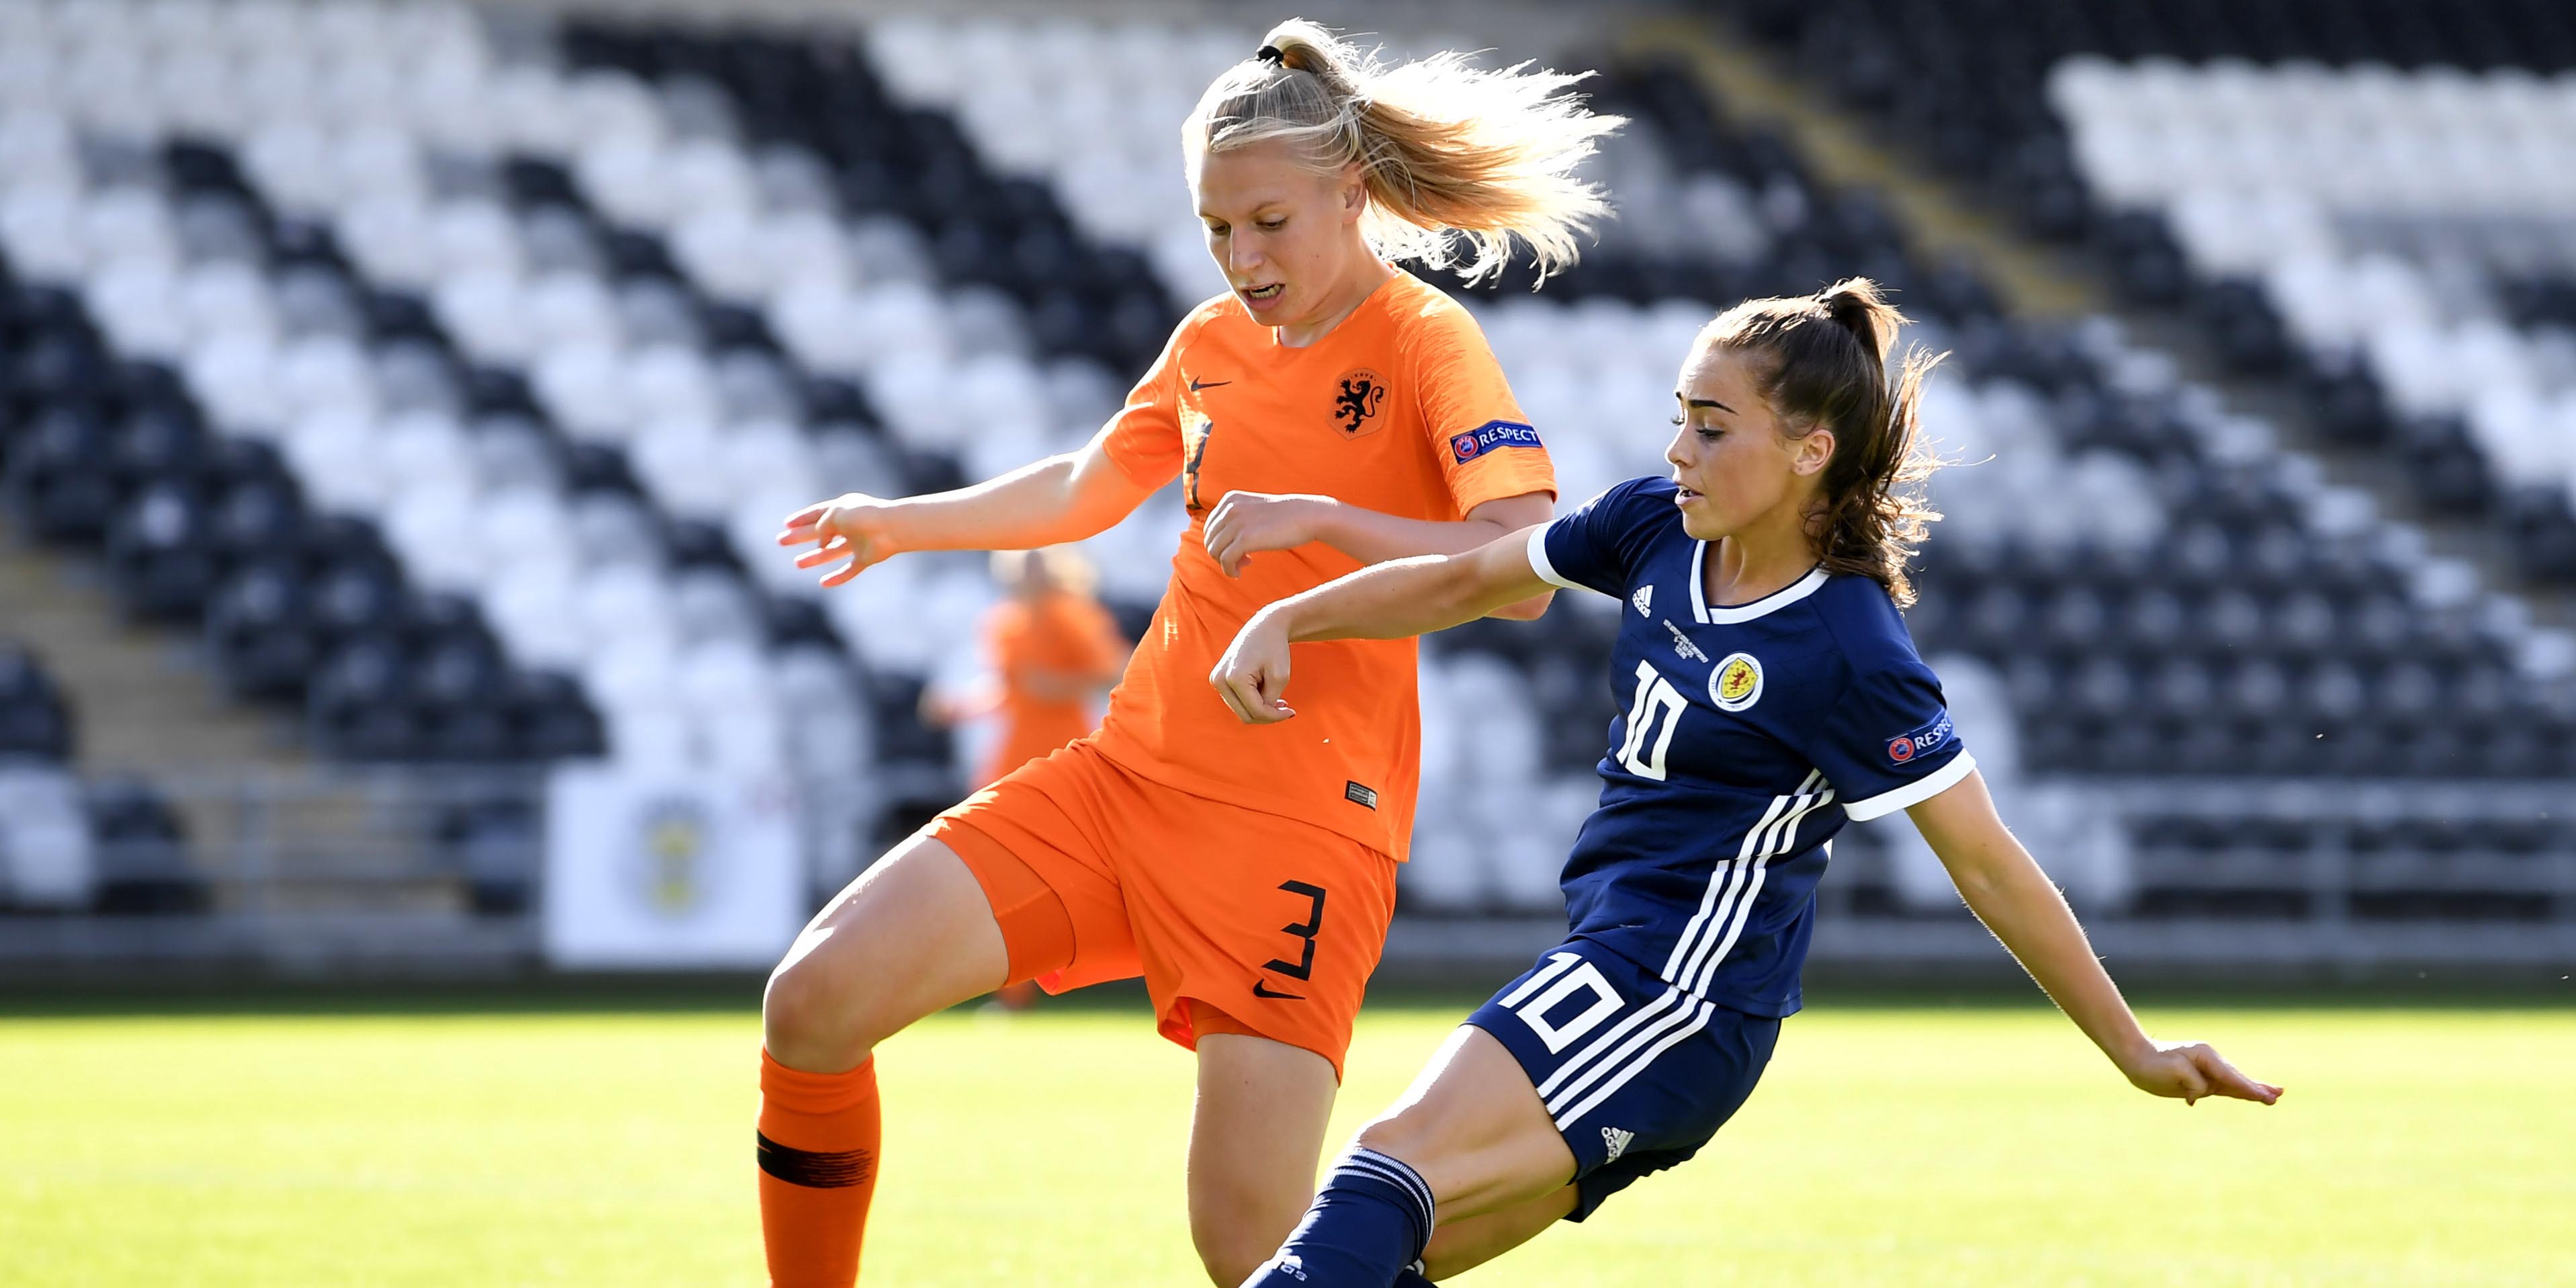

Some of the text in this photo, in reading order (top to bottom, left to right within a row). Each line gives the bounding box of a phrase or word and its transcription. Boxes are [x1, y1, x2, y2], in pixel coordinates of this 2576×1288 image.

[1479, 427, 1537, 447] RESPECT
[1616, 659, 1689, 781] 10
[1261, 879, 1326, 981] 3
[1497, 952, 1626, 1055] 10
